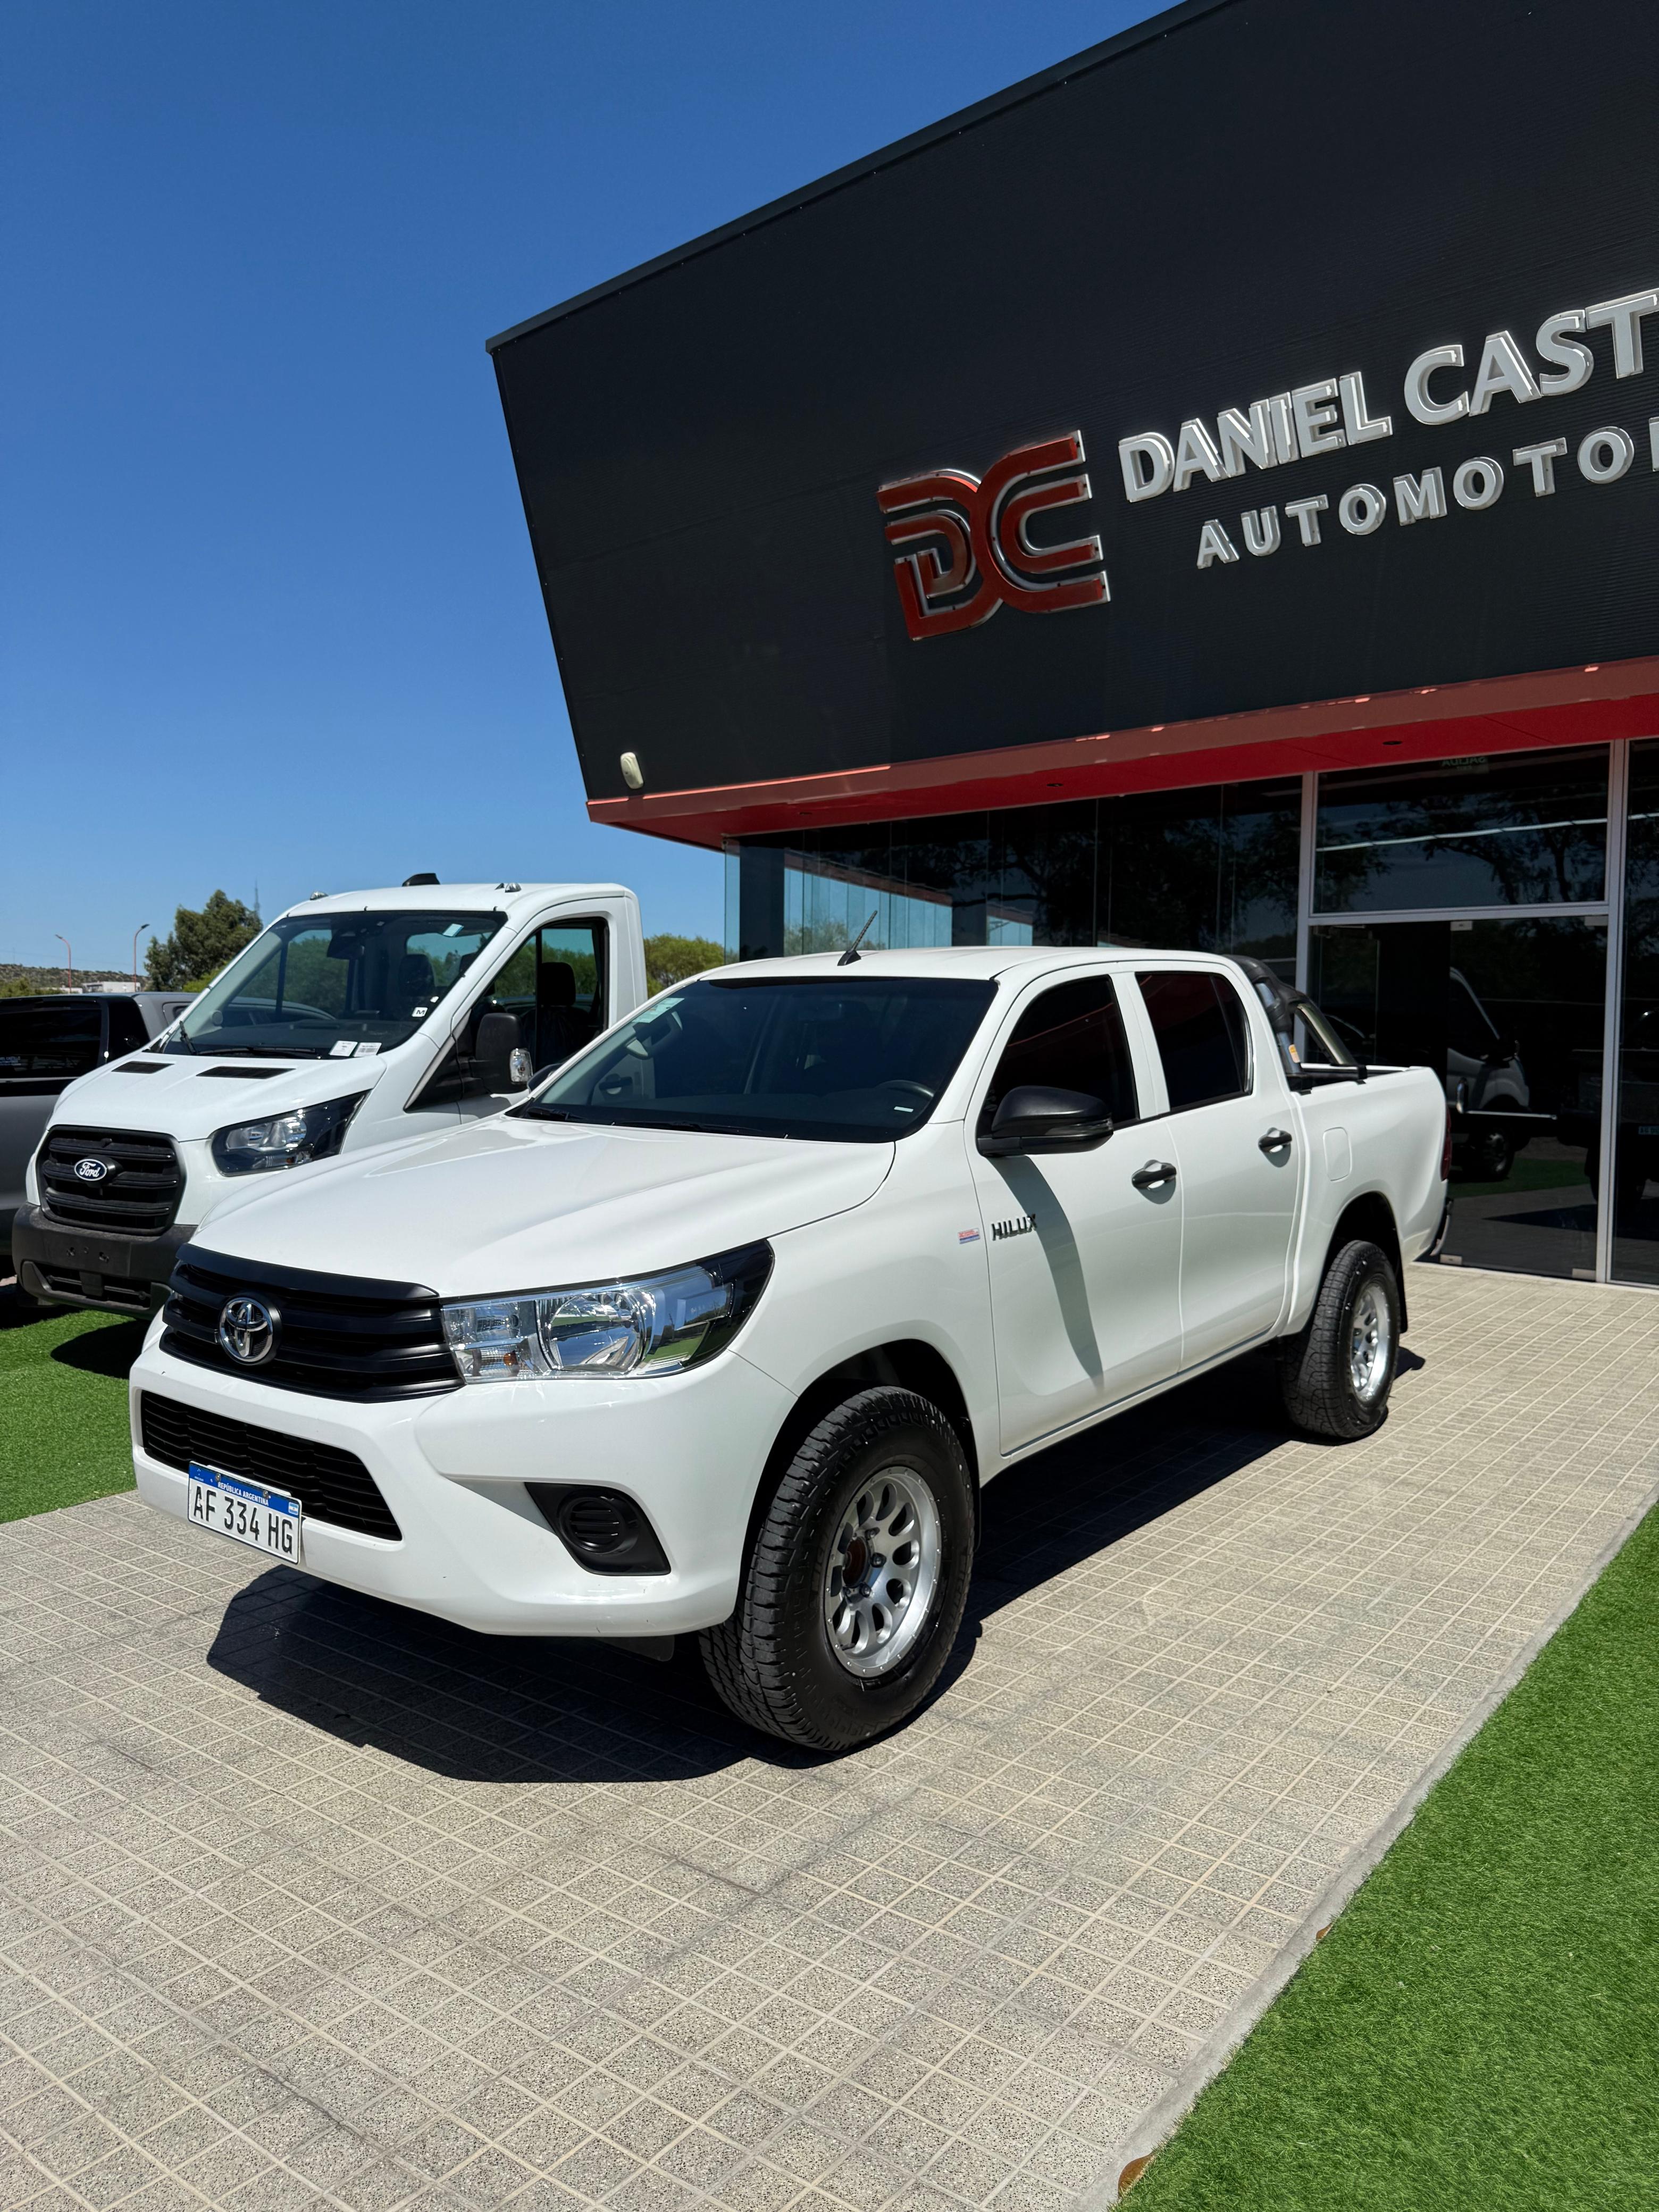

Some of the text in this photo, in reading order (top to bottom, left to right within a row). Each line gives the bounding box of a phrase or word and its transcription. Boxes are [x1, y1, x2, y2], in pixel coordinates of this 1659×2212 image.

[1118, 287, 1659, 503] DANIEL CAST
[1196, 416, 1659, 569] AUTOMOTO
[79, 1161, 100, 1178] Ford
[991, 1213, 1037, 1241] HILUX
[217, 1481, 269, 1506] REPÚBLICA ARGENTINA
[194, 1486, 293, 1554] AF 334 HG
